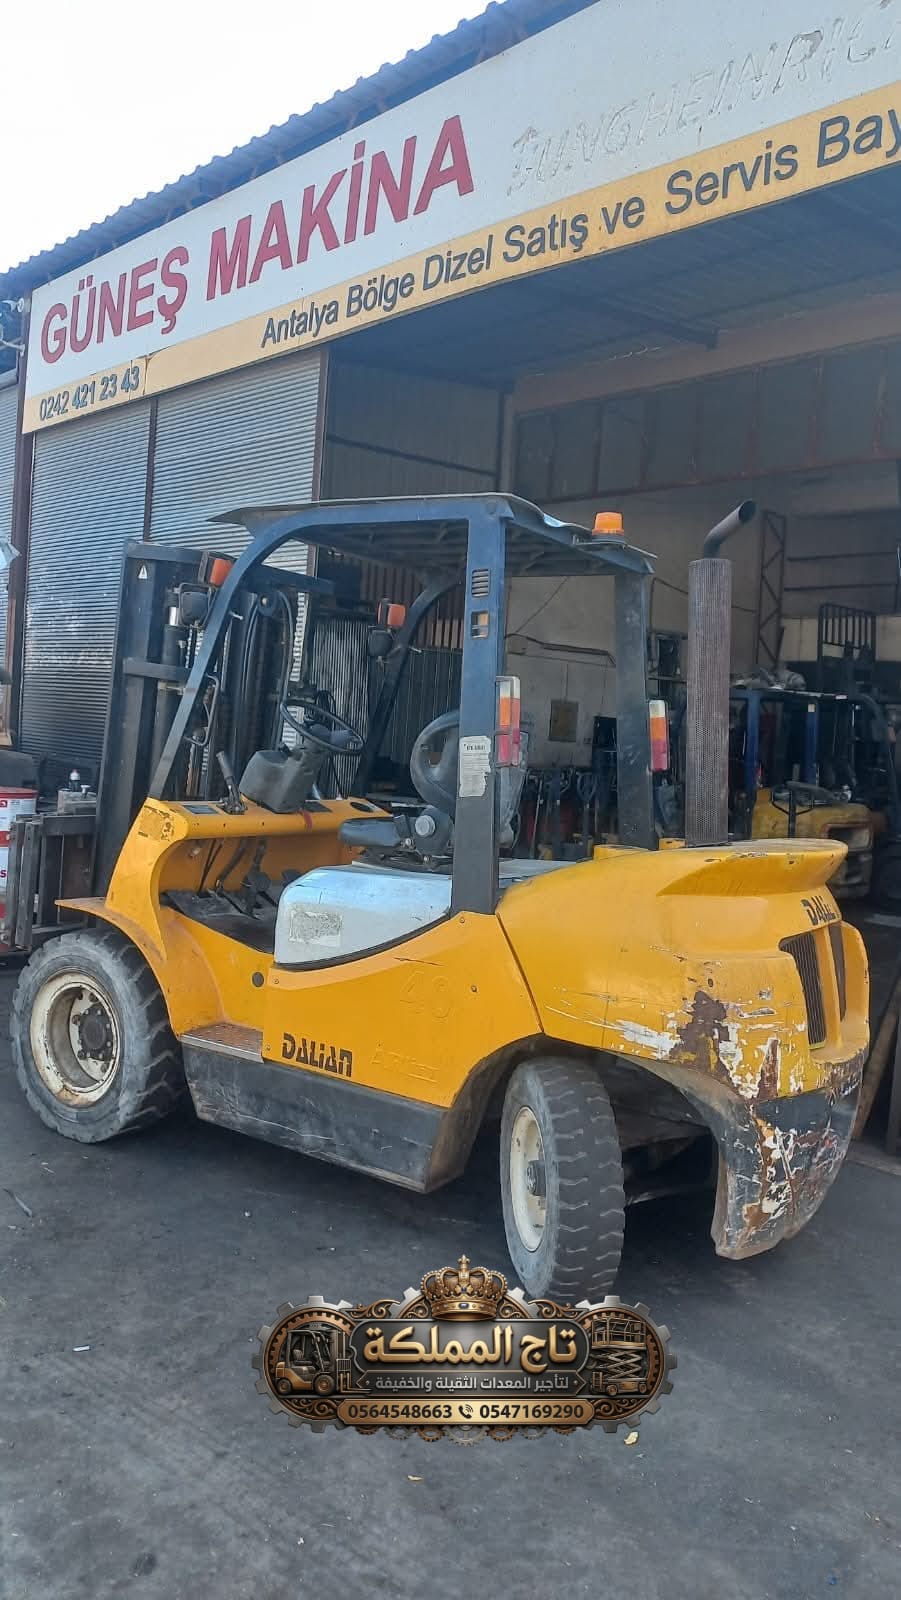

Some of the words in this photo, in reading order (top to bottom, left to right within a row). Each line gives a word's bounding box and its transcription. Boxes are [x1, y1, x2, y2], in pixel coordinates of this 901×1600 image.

[41, 246, 190, 365] GÜNEŞ
[206, 115, 475, 301] MAKİNA
[261, 301, 339, 348] Antalya
[346, 274, 415, 318] Bölge
[423, 234, 493, 290] Dizel
[502, 213, 588, 263] Satış
[600, 196, 645, 234] ve
[664, 140, 799, 215] Servis
[40, 390, 70, 421] 0242
[72, 381, 96, 410] 421
[99, 373, 118, 401] 23
[120, 365, 140, 393] 43
